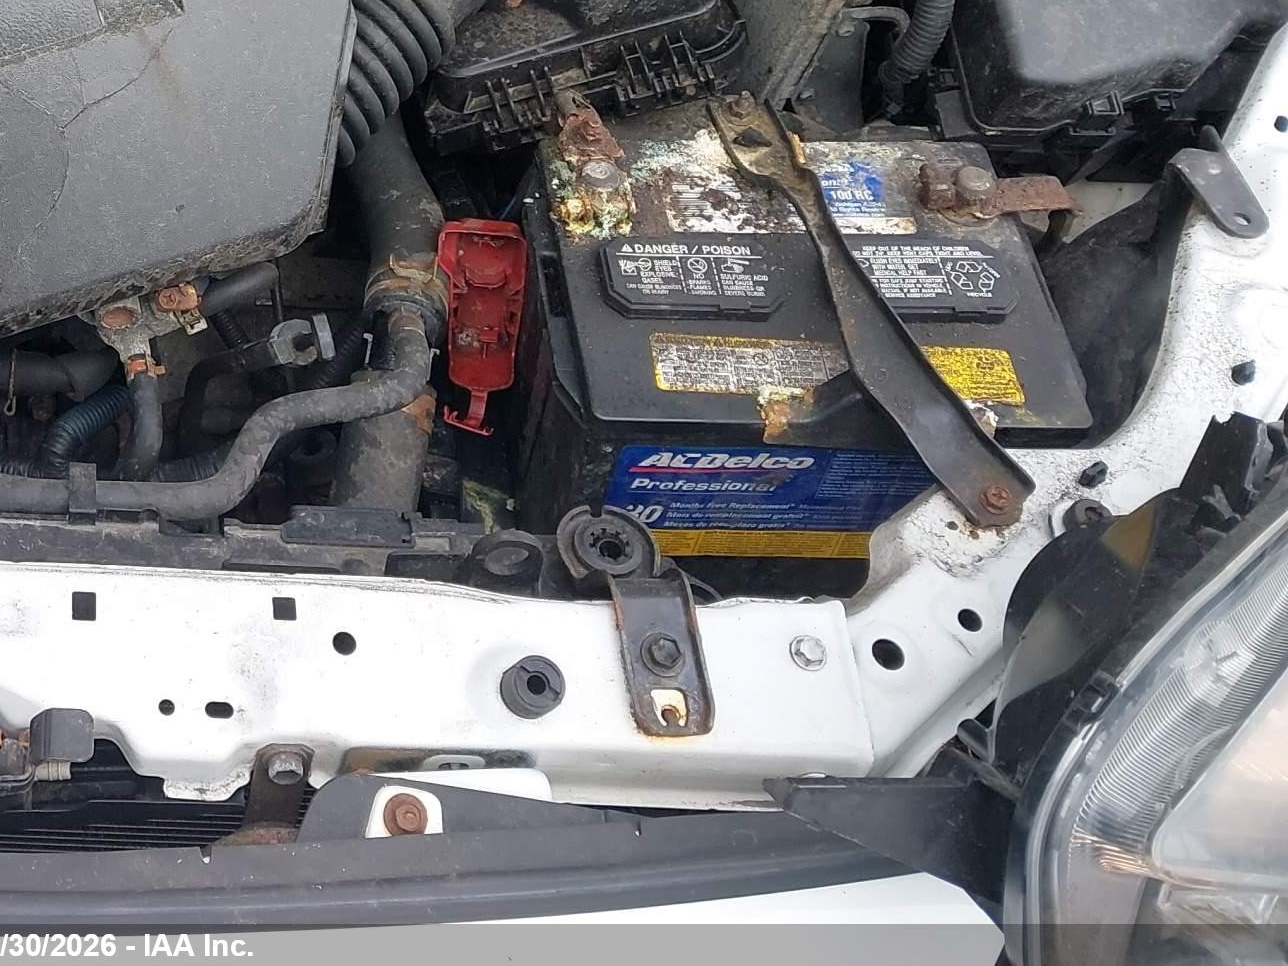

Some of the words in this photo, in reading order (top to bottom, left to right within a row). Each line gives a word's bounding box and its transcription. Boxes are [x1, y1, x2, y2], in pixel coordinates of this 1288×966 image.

[634, 243, 688, 255] DANGER
[702, 245, 751, 256] POISON
[637, 452, 815, 469] ACDelco
